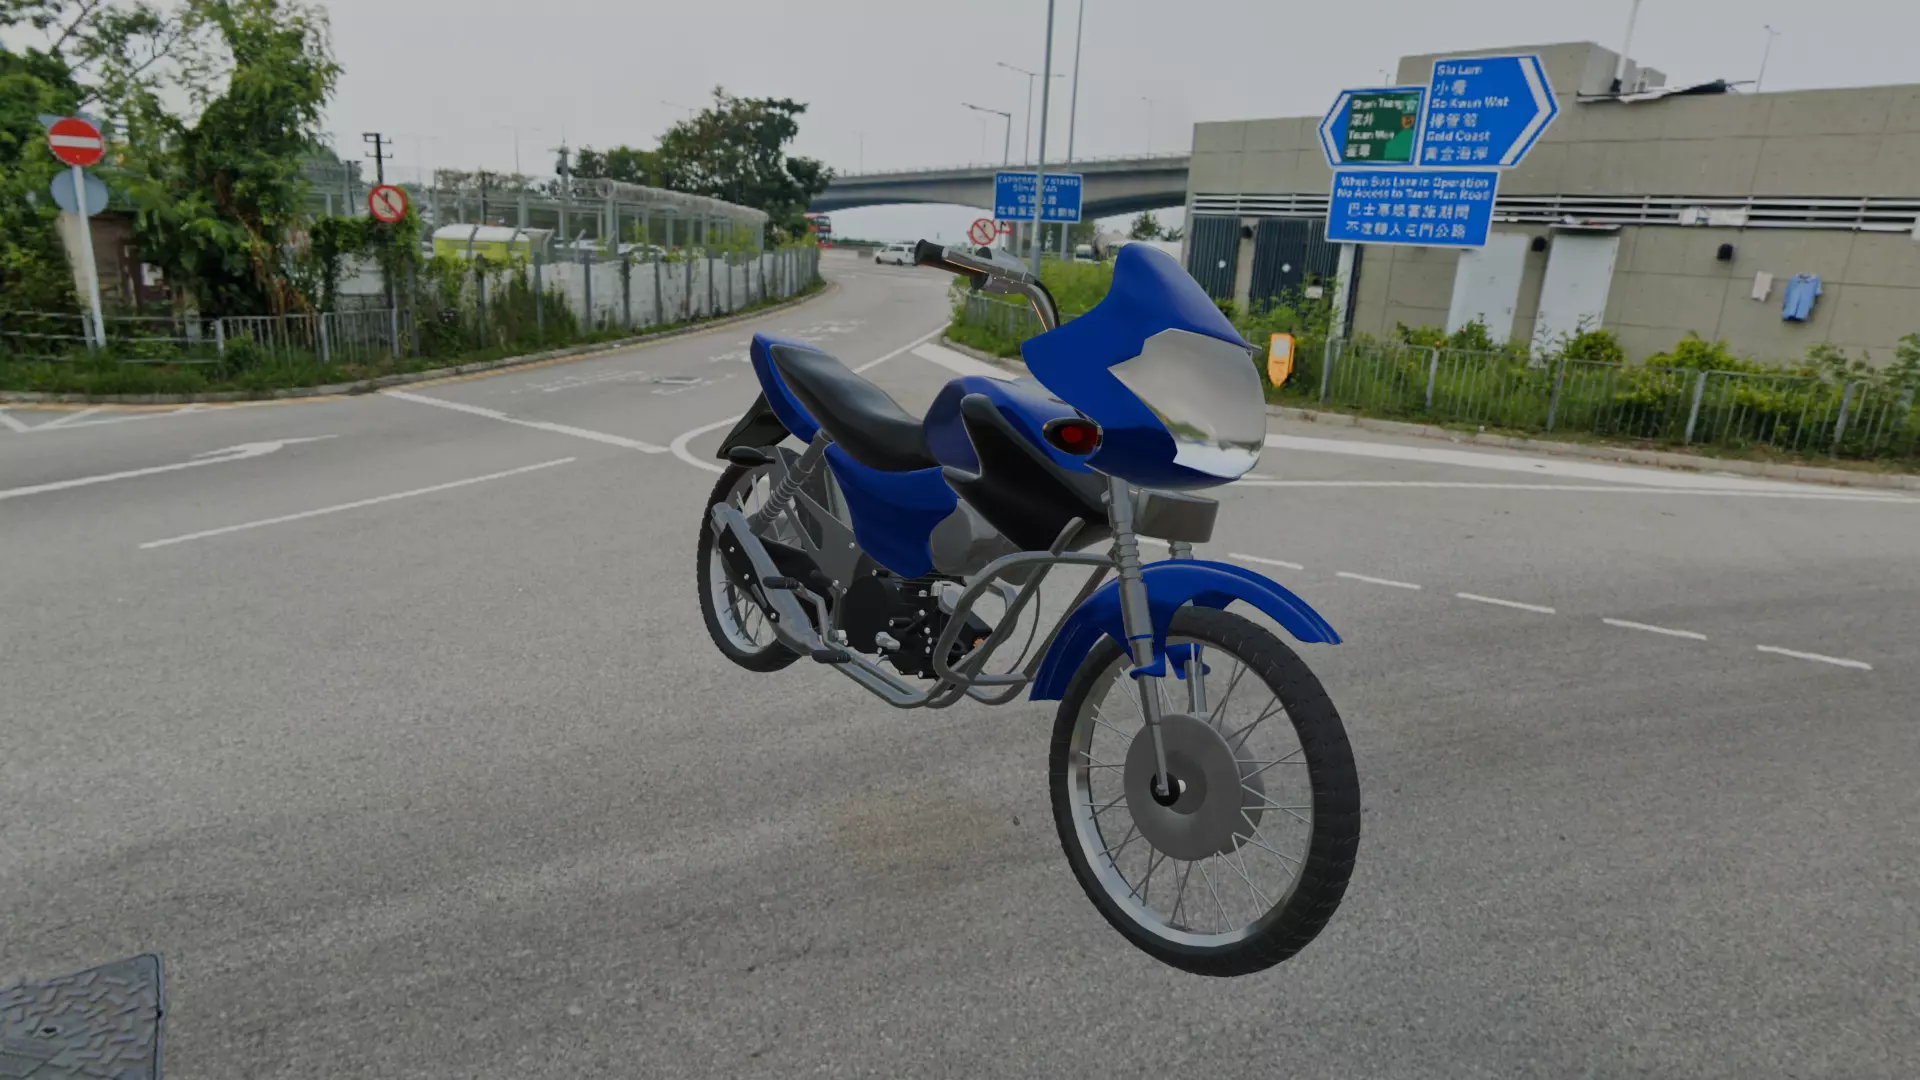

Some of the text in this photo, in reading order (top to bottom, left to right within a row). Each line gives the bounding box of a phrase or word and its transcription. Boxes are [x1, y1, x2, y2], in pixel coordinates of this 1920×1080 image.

[1437, 65, 1482, 75] Siu Lam
[1432, 98, 1447, 108] So
[1485, 96, 1509, 108] Wat
[1427, 130, 1491, 142] Gold Coast
[1341, 176, 1368, 187] When
[1371, 176, 1391, 187] Bus
[1393, 176, 1417, 187] Lane
[1433, 177, 1489, 188] Operation
[1336, 188, 1353, 198] No
[1355, 188, 1389, 199] Access
[1391, 188, 1404, 198] to
[1459, 189, 1490, 200] Road
